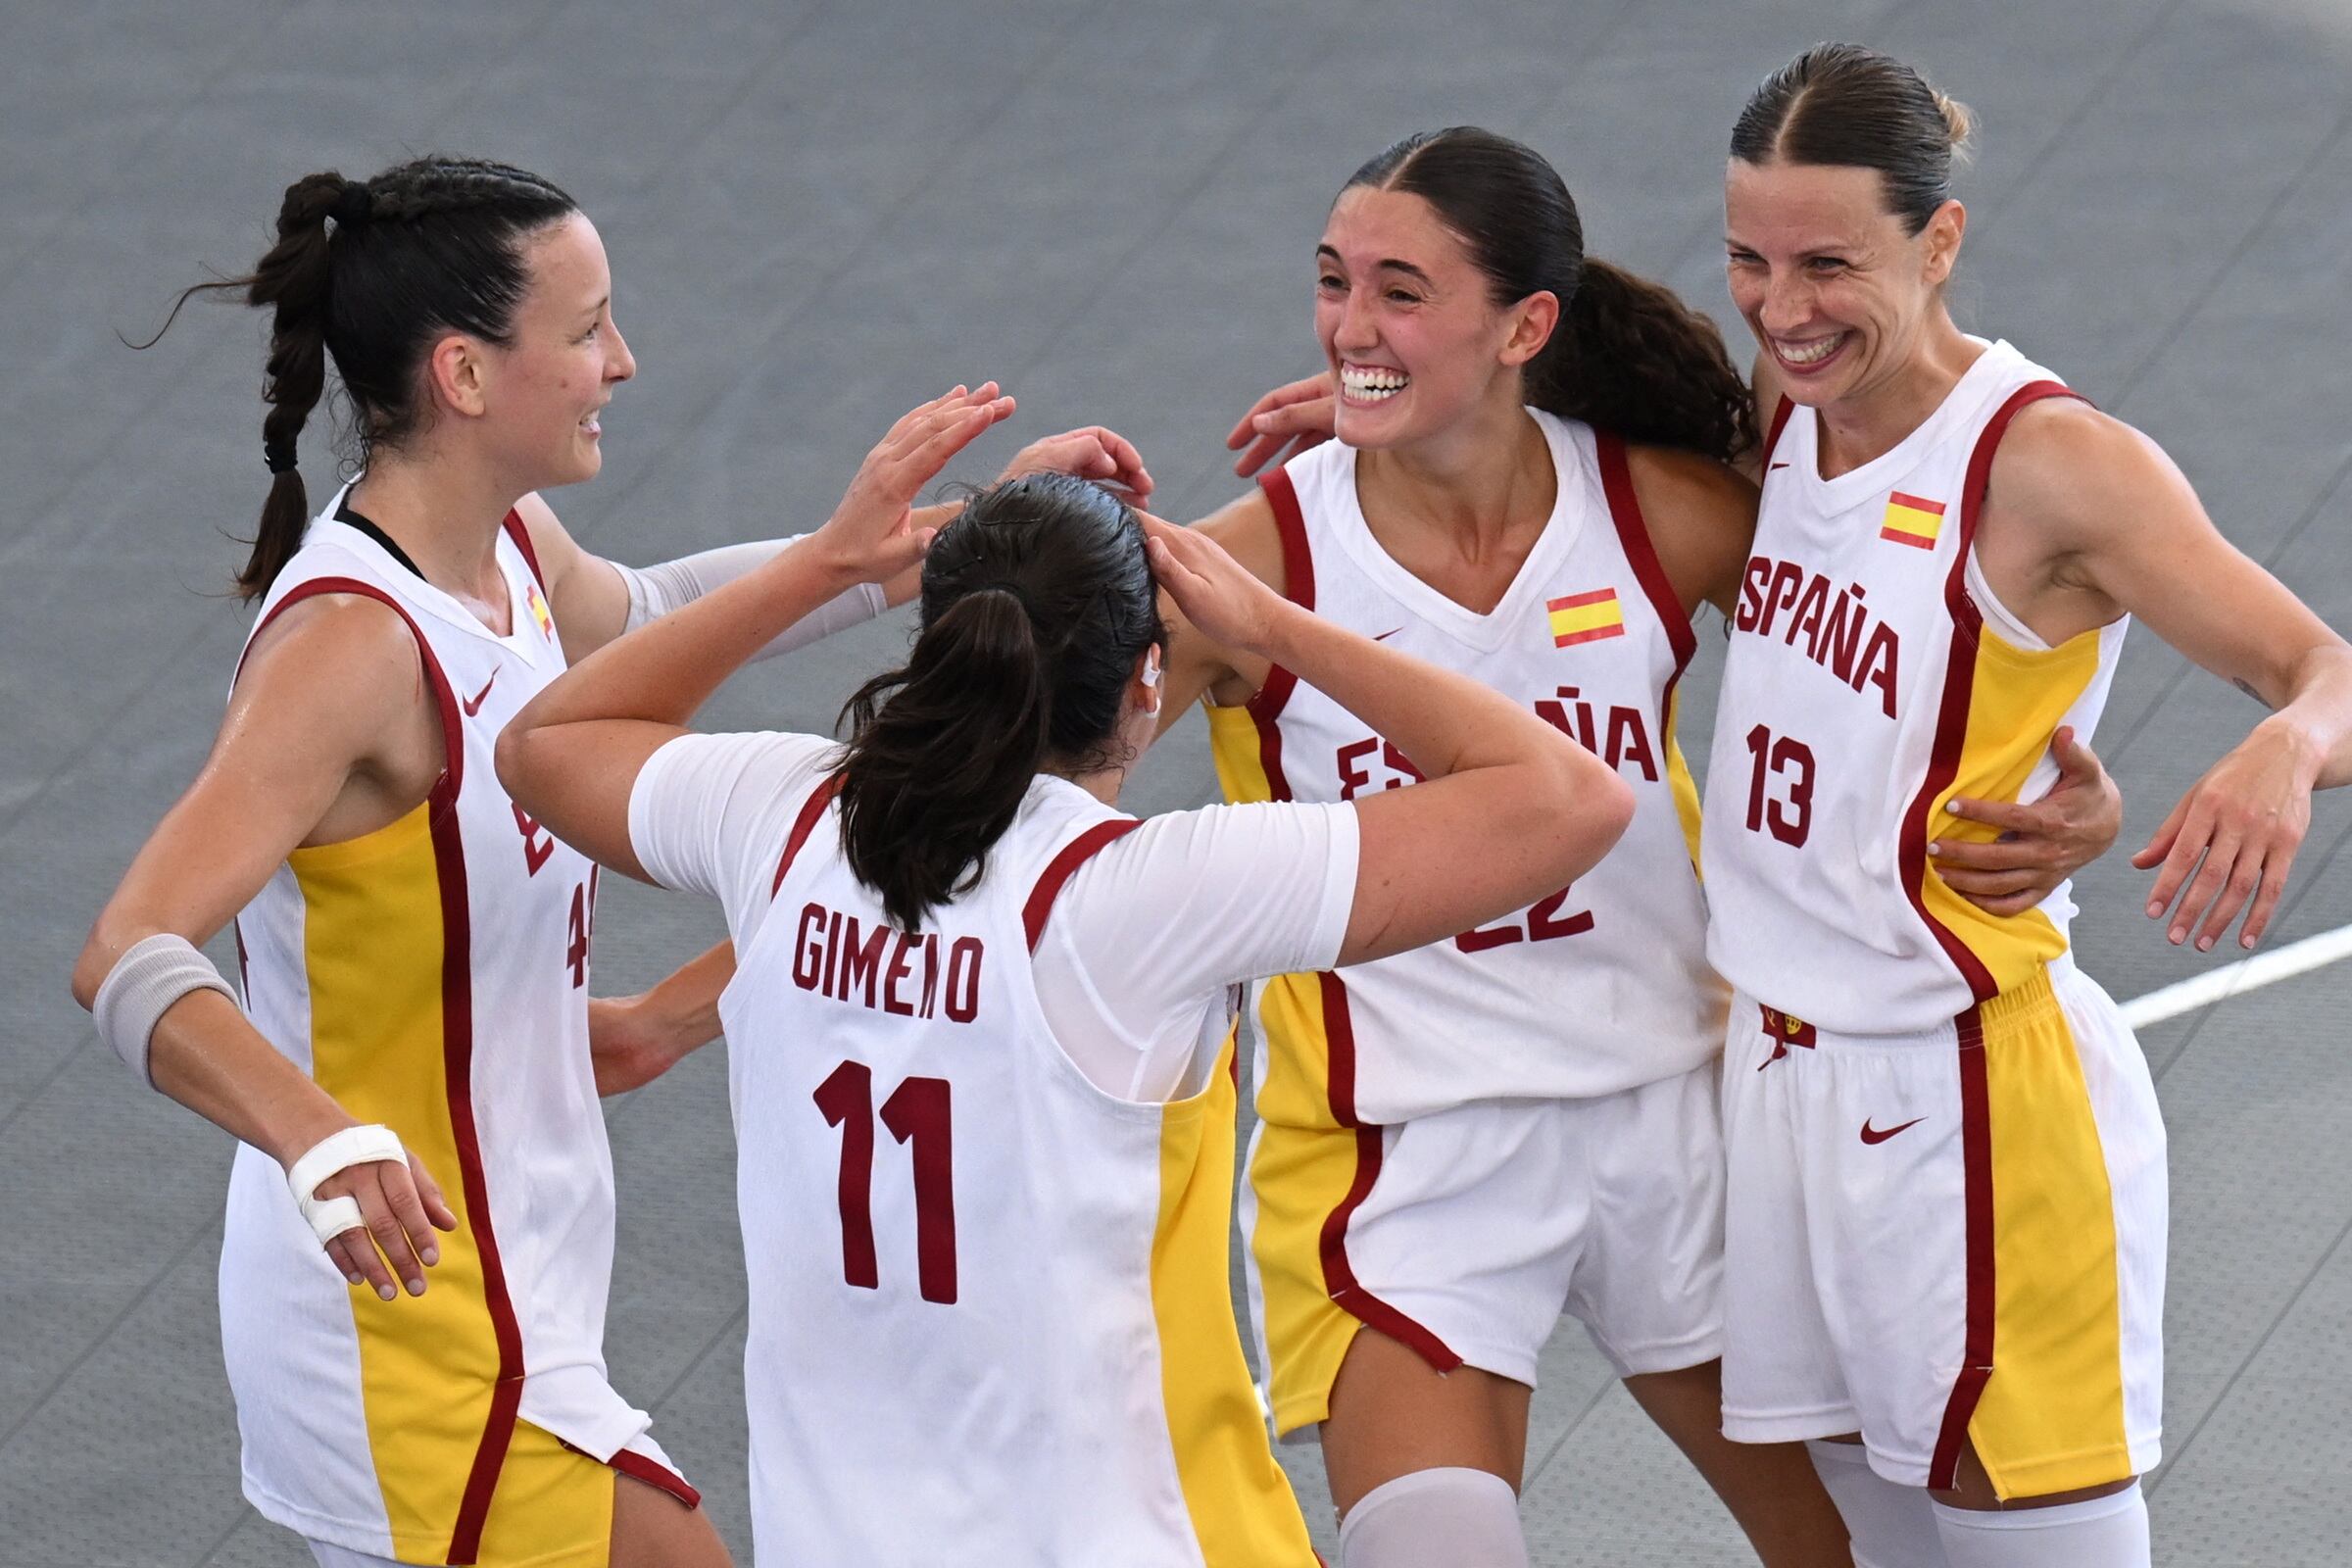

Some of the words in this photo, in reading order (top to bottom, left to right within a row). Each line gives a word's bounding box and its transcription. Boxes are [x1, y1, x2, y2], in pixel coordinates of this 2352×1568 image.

[1736, 556, 1899, 720] SPAÑA
[1746, 723, 1816, 849] 13
[566, 861, 599, 990] 4
[1454, 882, 1594, 954] 2
[812, 1059, 957, 1305] 11
